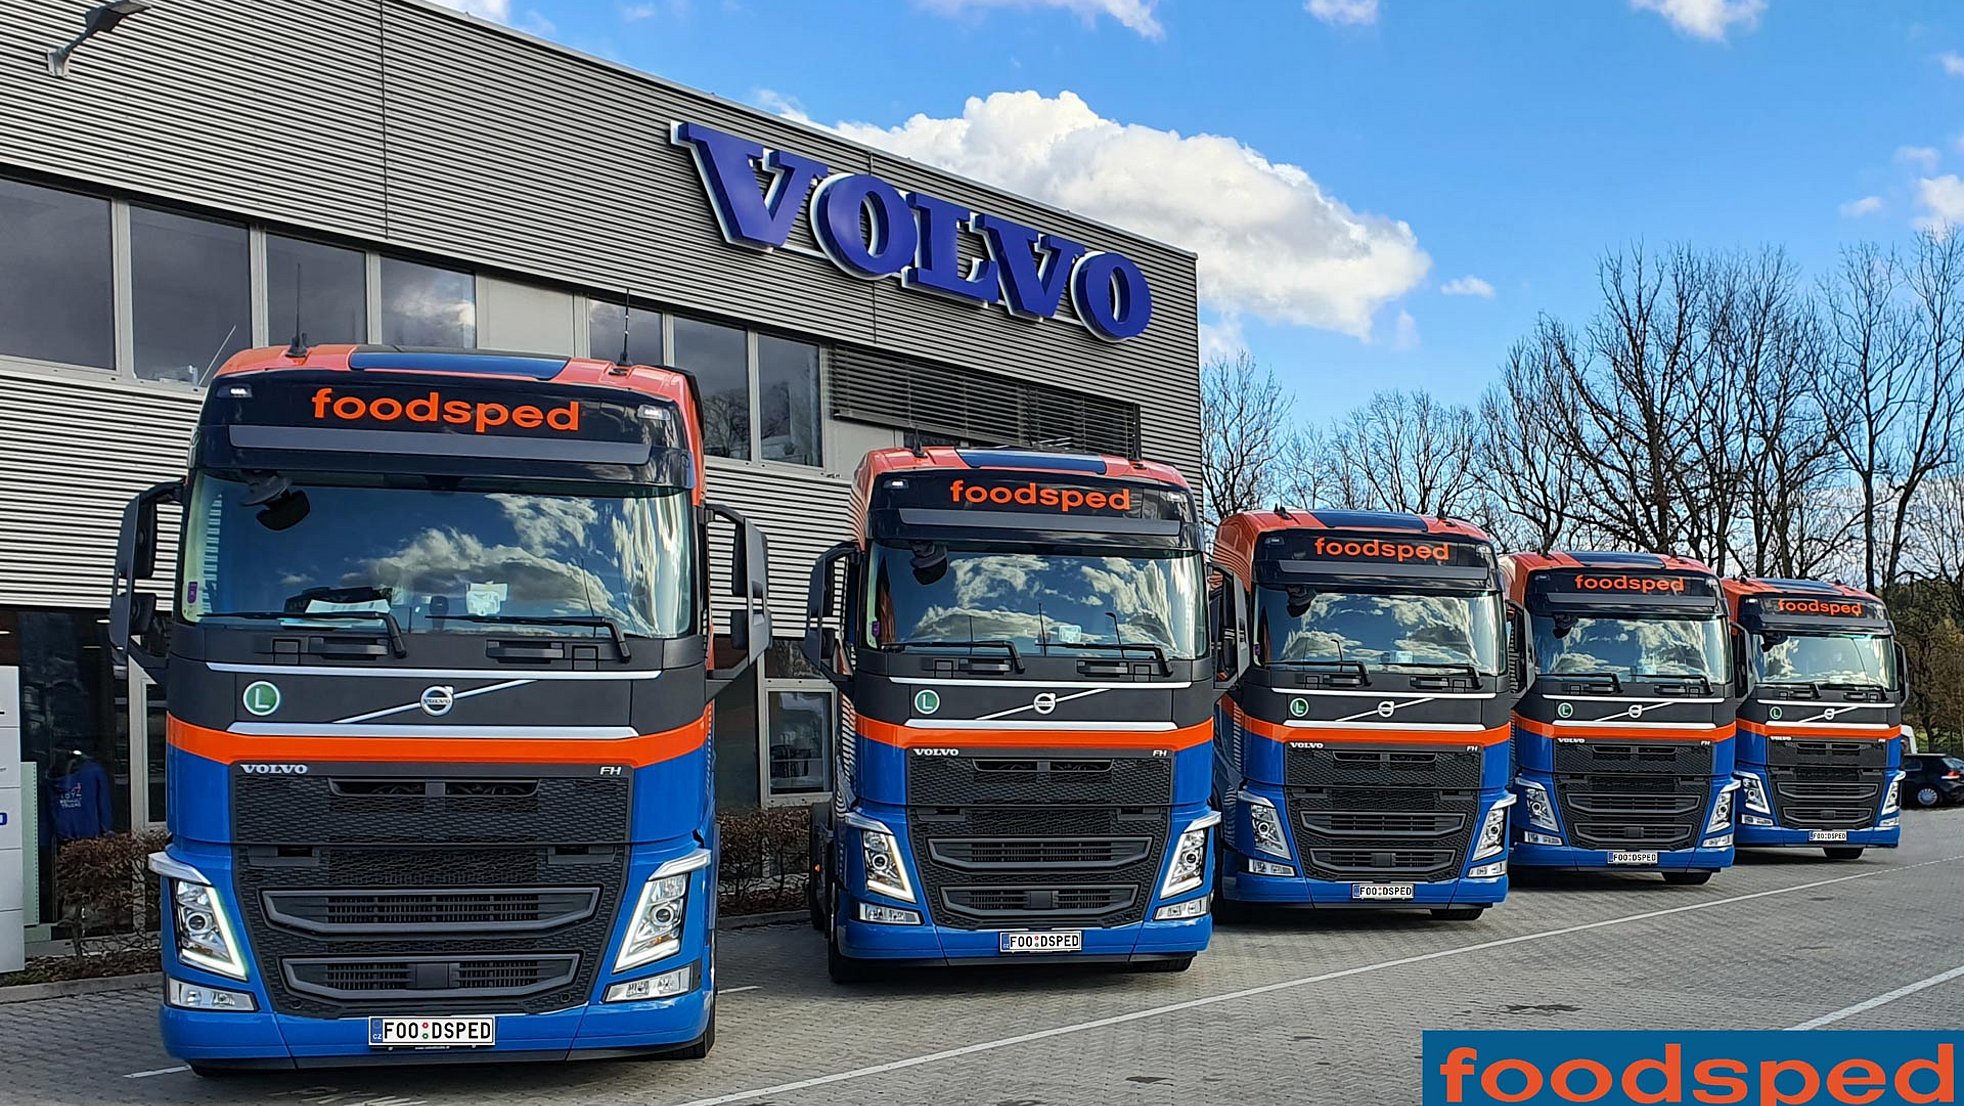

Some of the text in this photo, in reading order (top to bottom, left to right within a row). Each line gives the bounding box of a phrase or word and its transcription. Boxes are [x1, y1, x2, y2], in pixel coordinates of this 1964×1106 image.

[671, 120, 1152, 342] VOLVO
[312, 387, 580, 433] foodsped
[950, 479, 1131, 512] foodsped
[1314, 537, 1450, 561] foodsped
[1575, 574, 1685, 592] foodsped
[1778, 599, 1862, 616] foodsped
[913, 748, 959, 756] VOLVO
[240, 764, 308, 774] VOLVO
[600, 766, 622, 775] FH
[1382, 886, 1412, 896] DSPED
[1040, 935, 1079, 947] DSPED
[432, 1022, 491, 1039] DSPED
